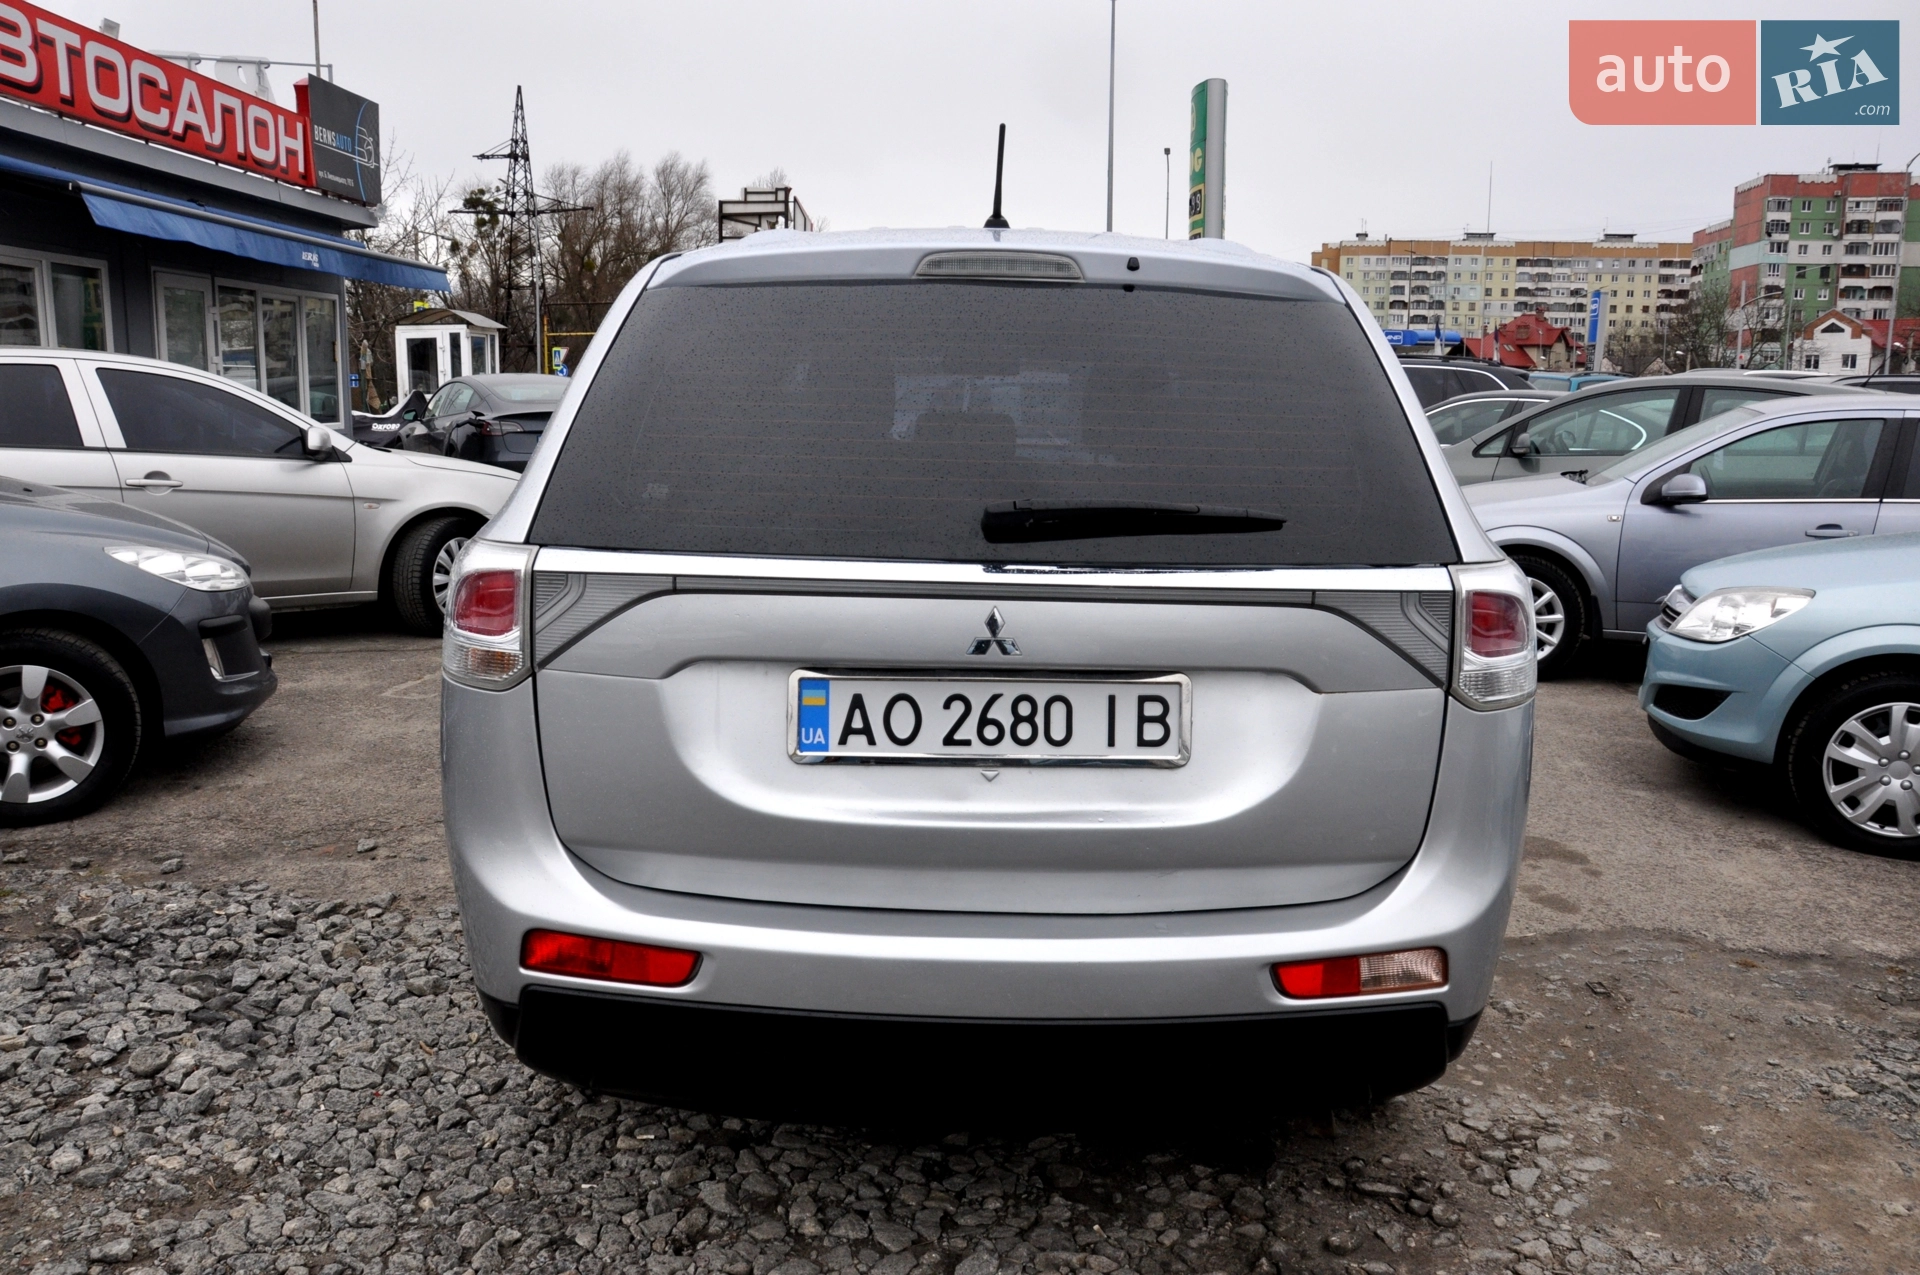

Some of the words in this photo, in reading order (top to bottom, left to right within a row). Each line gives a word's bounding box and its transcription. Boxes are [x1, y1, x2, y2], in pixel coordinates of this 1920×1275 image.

[801, 728, 826, 745] UA
[837, 692, 923, 747] AO
[942, 693, 1073, 748] 2680
[1107, 694, 1171, 748] IB
